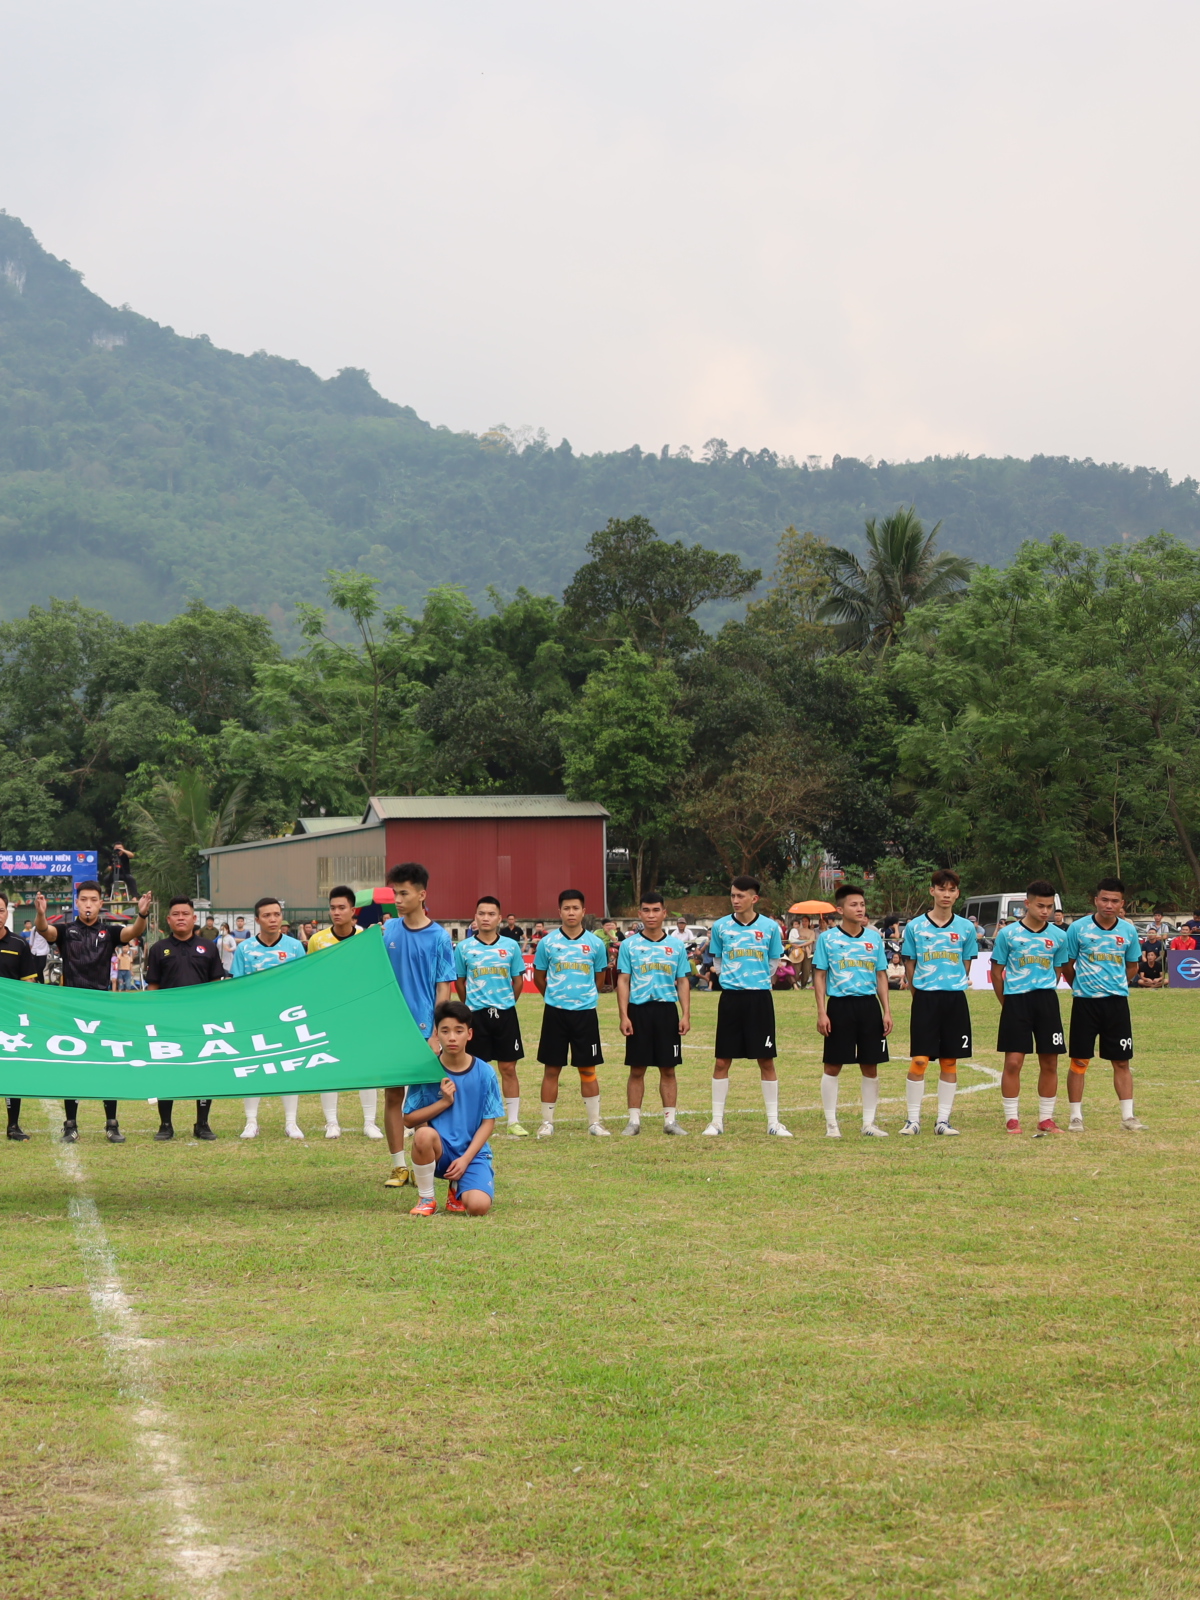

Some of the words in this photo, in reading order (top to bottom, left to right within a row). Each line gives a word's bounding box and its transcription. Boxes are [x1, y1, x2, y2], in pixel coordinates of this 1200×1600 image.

[29, 854, 54, 862] THANH
[55, 853, 72, 862] NIÊN
[49, 864, 72, 873] 2026
[514, 1038, 520, 1051] 6
[765, 1035, 773, 1048] 4
[961, 1035, 969, 1049] 2
[1052, 1032, 1064, 1045] 88
[1119, 1037, 1132, 1051] 99
[880, 1039, 886, 1052] 7
[233, 1052, 340, 1078] FIFA
